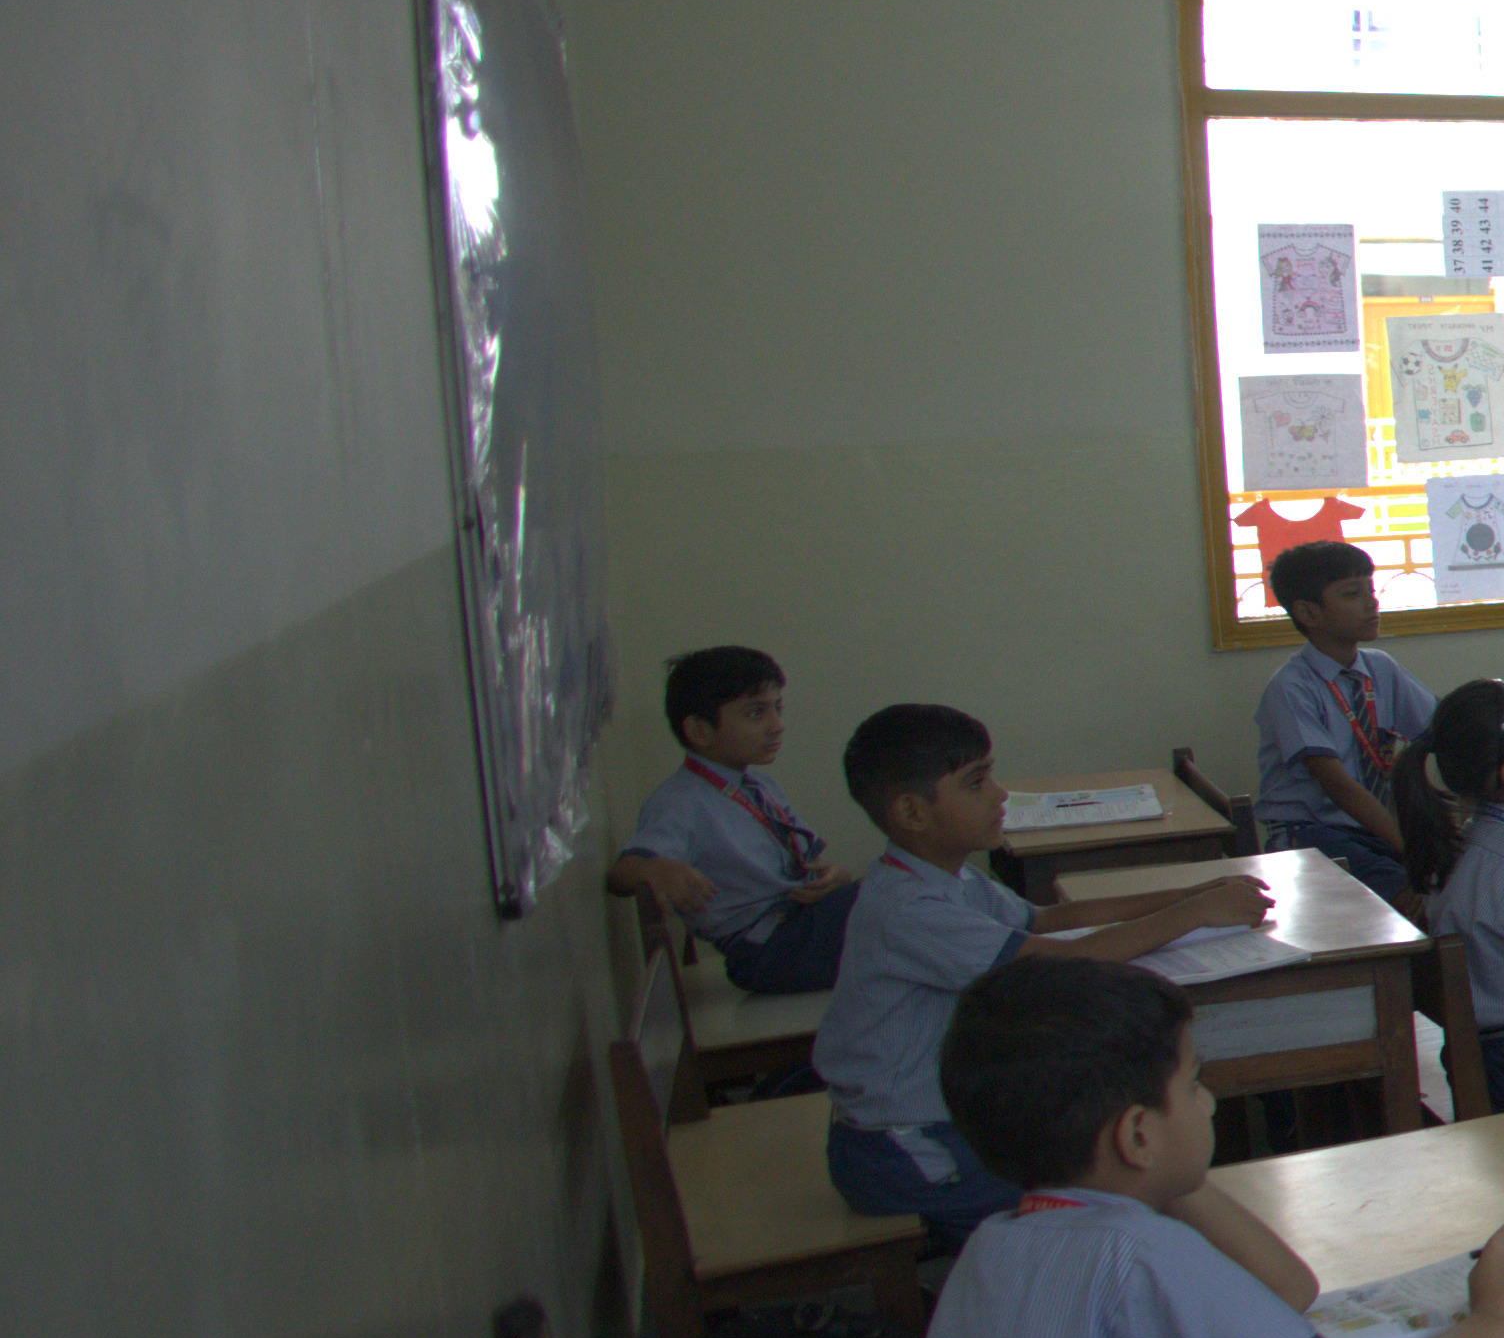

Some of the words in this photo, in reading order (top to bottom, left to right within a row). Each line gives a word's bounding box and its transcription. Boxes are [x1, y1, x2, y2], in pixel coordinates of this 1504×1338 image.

[1449, 197, 1462, 214] 40
[1477, 197, 1489, 213] 44
[1451, 219, 1463, 236] 39
[1479, 219, 1491, 235] 43
[1452, 239, 1465, 255] 38
[1480, 238, 1492, 254] 42
[1453, 258, 1466, 275] 37
[1481, 258, 1493, 274] 41
